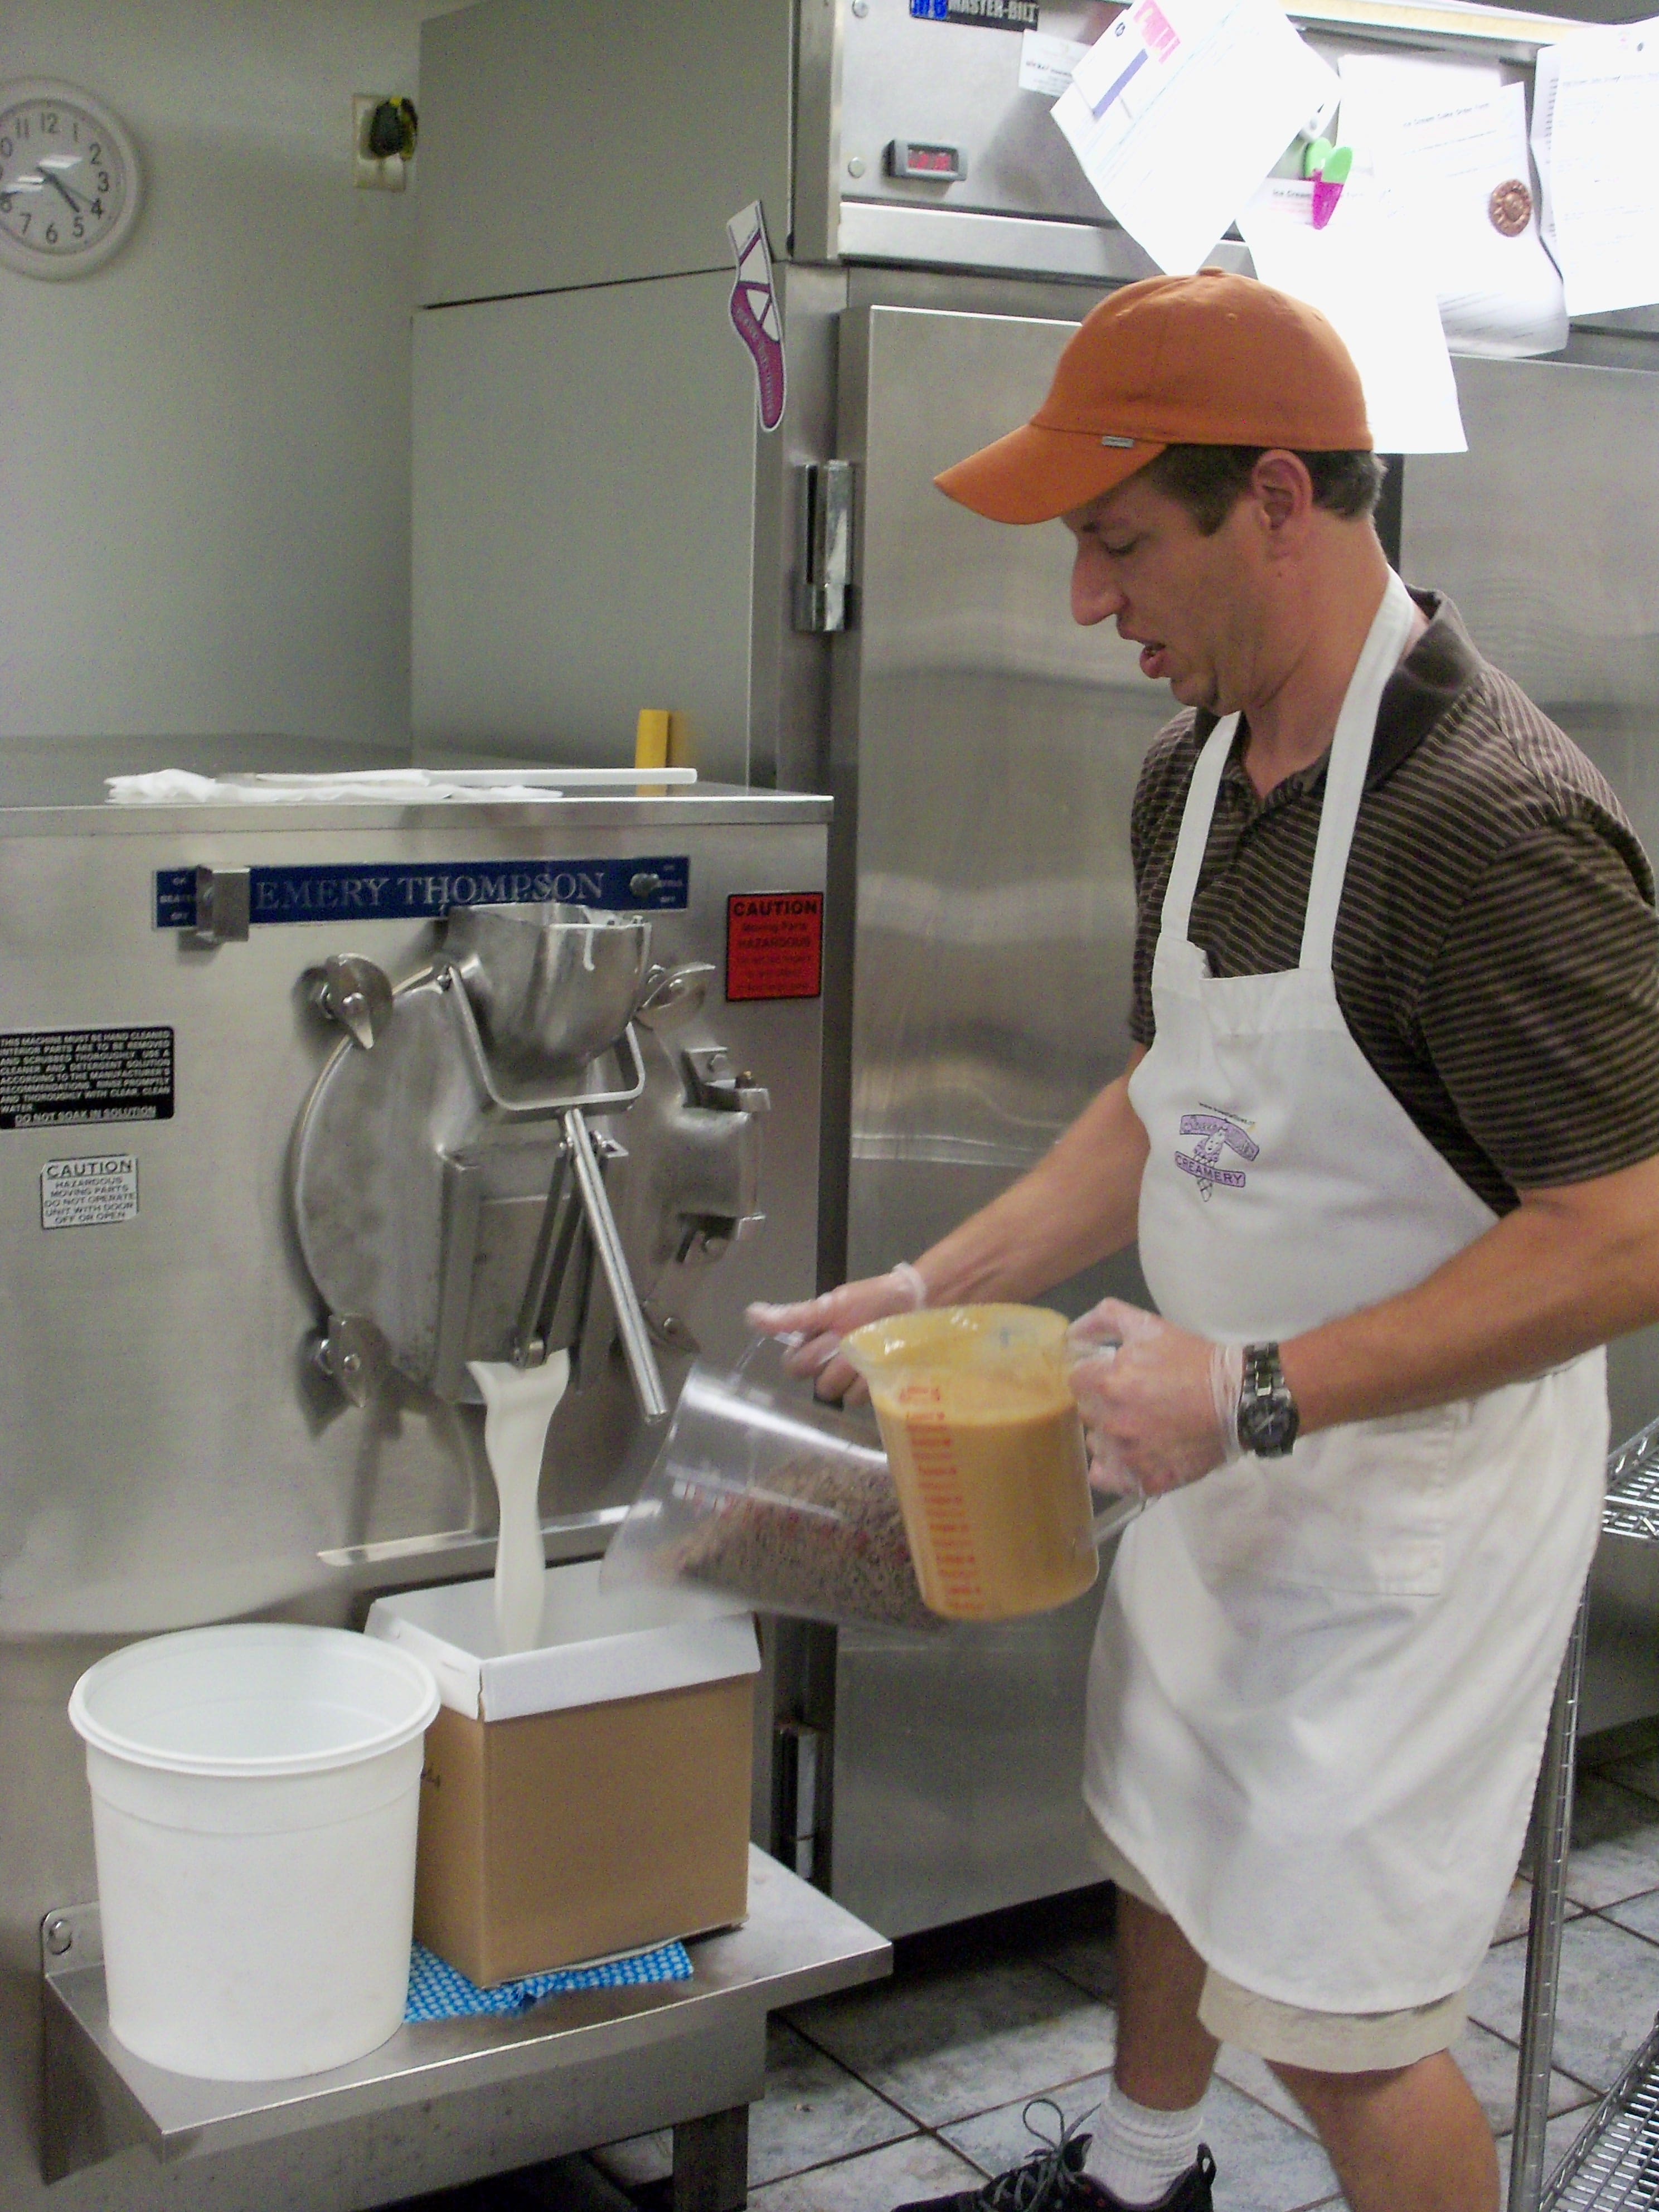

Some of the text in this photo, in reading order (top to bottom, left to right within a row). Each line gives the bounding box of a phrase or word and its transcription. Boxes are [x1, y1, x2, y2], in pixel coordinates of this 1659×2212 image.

[16, 118, 28, 138] 11
[41, 112, 57, 134] 12
[89, 142, 101, 165] 2
[98, 171, 109, 192] 3
[90, 197, 103, 220] 4
[20, 213, 31, 235] 7
[72, 216, 84, 237] 5
[46, 222, 57, 244] 6
[255, 872, 604, 909] EMERY THOMPSON
[734, 900, 817, 916] CAUTION
[738, 937, 811, 947] HAZARDOUS
[21, 1036, 62, 1045] MACHINE
[64, 1034, 90, 1044] MUST
[104, 1032, 129, 1041] HAND
[130, 1031, 170, 1040] CLEANED
[43, 1045, 72, 1054] PARTS
[75, 1044, 94, 1052] ARE
[113, 1042, 124, 1050] BE
[127, 1040, 170, 1049] REMOVED
[1, 1057, 20, 1065] AND
[23, 1054, 72, 1064] SCRUBBED
[45, 1064, 66, 1073] AND
[70, 1061, 122, 1071] DETERGENT
[127, 1059, 171, 1069] SOLUTION
[1, 1074, 55, 1084] ACCORDING
[124, 1077, 170, 1086] PROMPTLY
[1, 1095, 20, 1104] AND
[23, 1092, 82, 1102] THOROUGHLY
[85, 1090, 108, 1099] WITH
[15, 1114, 31, 1123] DO
[33, 1112, 55, 1122] NOT
[58, 1110, 87, 1120] SOAK
[103, 1106, 156, 1118] SOLUTION
[47, 1160, 132, 1178] CAUTION
[1175, 1154, 1242, 1185] CREAMERY
[51, 1185, 128, 1196] MOVING PARTS
[56, 1177, 122, 1188] HAZARDOUS
[88, 1193, 133, 1202] OPERATE
[45, 1208, 70, 1216] UNIT
